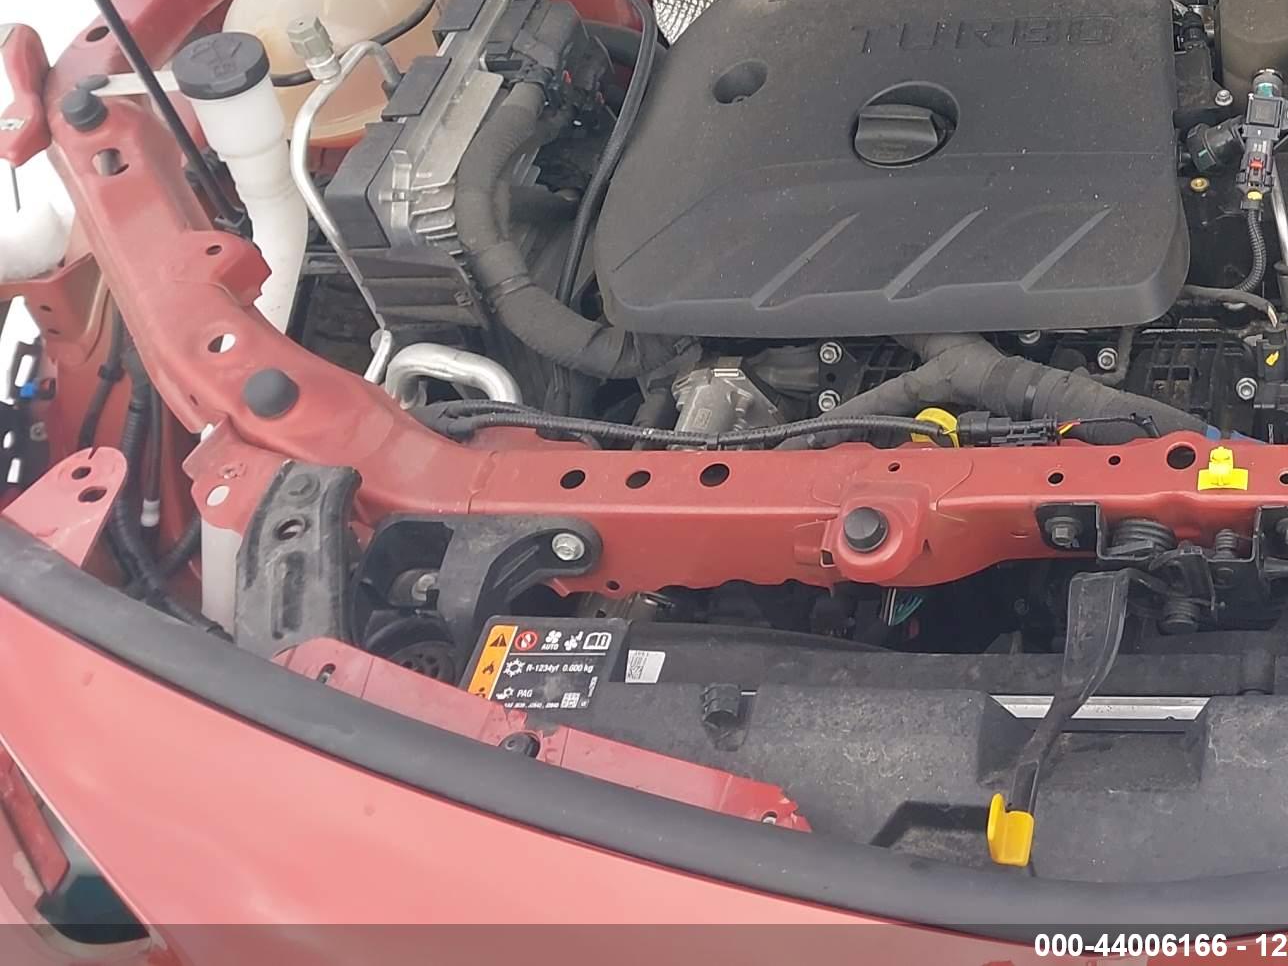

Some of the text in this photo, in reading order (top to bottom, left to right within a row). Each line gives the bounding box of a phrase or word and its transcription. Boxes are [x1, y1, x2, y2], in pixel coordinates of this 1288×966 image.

[851, 14, 1116, 54] TURBO
[541, 643, 559, 651] AUTO
[583, 664, 594, 674] kg
[516, 689, 533, 698] PAG
